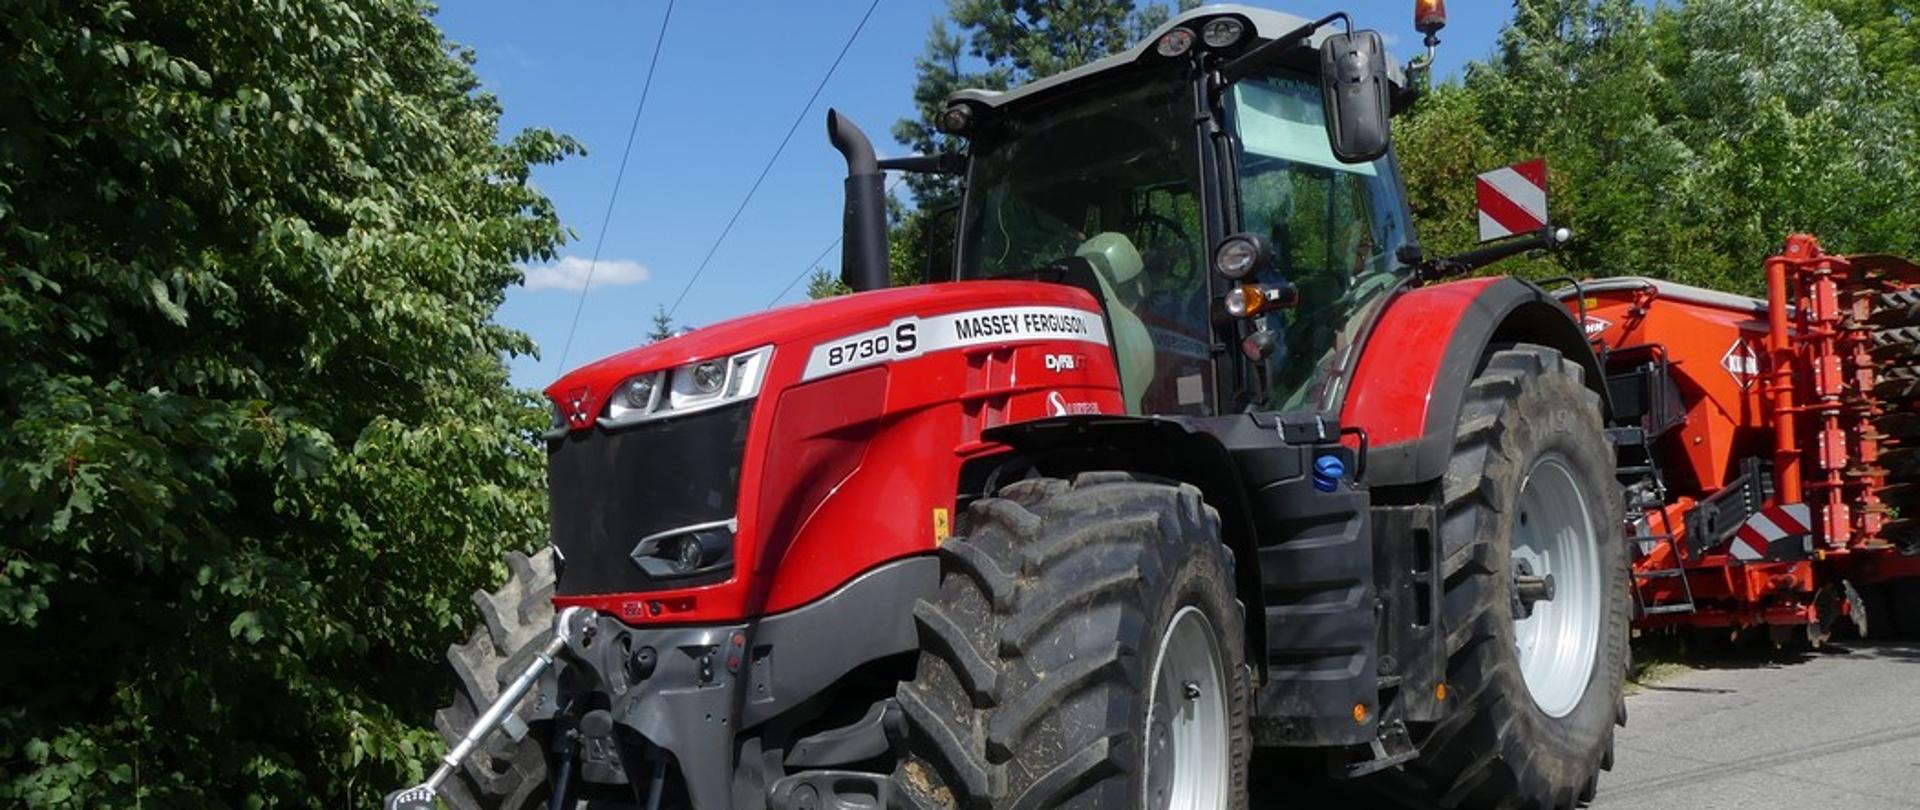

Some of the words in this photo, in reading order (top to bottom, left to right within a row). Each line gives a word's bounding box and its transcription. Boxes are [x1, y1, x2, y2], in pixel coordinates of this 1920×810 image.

[829, 335, 889, 367] 8730
[895, 323, 917, 354] S
[954, 314, 1019, 340] MASSEY
[1023, 313, 1088, 335] FERGUSON
